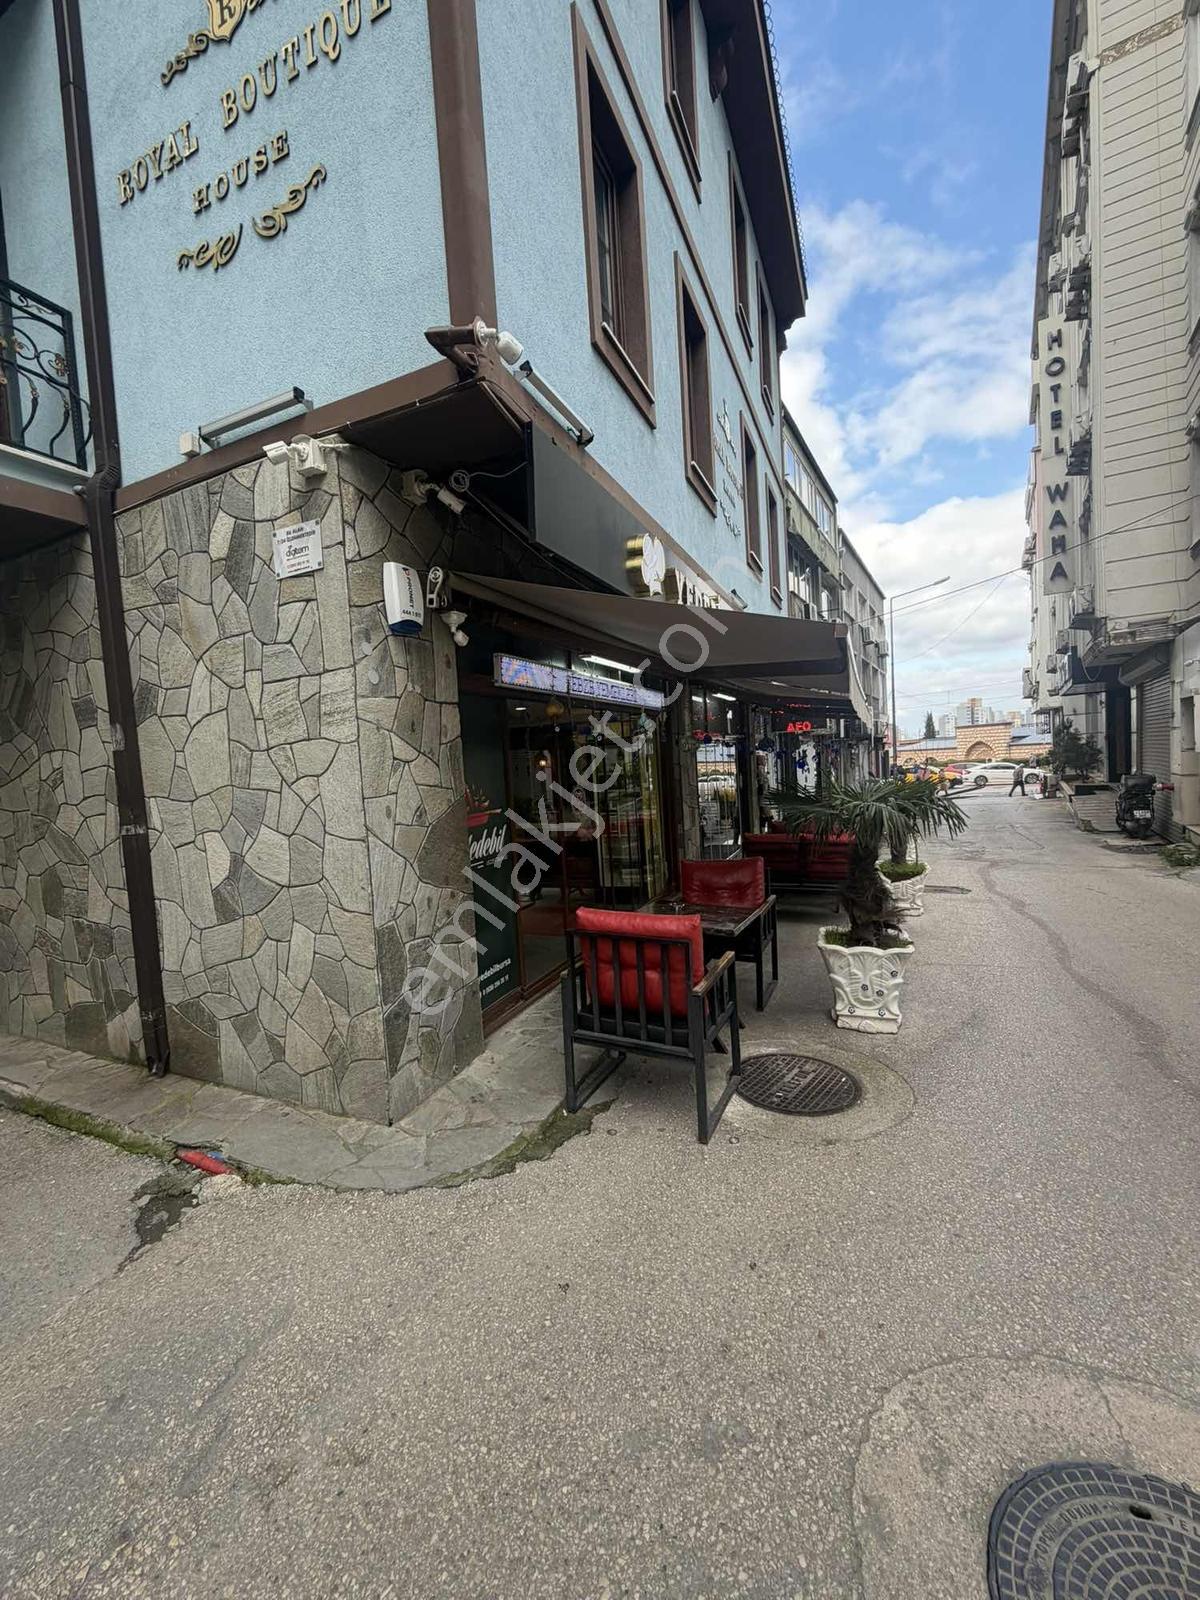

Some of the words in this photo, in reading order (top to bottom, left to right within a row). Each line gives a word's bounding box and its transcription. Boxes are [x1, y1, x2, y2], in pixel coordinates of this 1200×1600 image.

[116, 121, 199, 205] ROYAL
[191, 129, 290, 214] HOUSE
[1045, 328, 1066, 456] HOTEL
[469, 824, 507, 860] edebil
